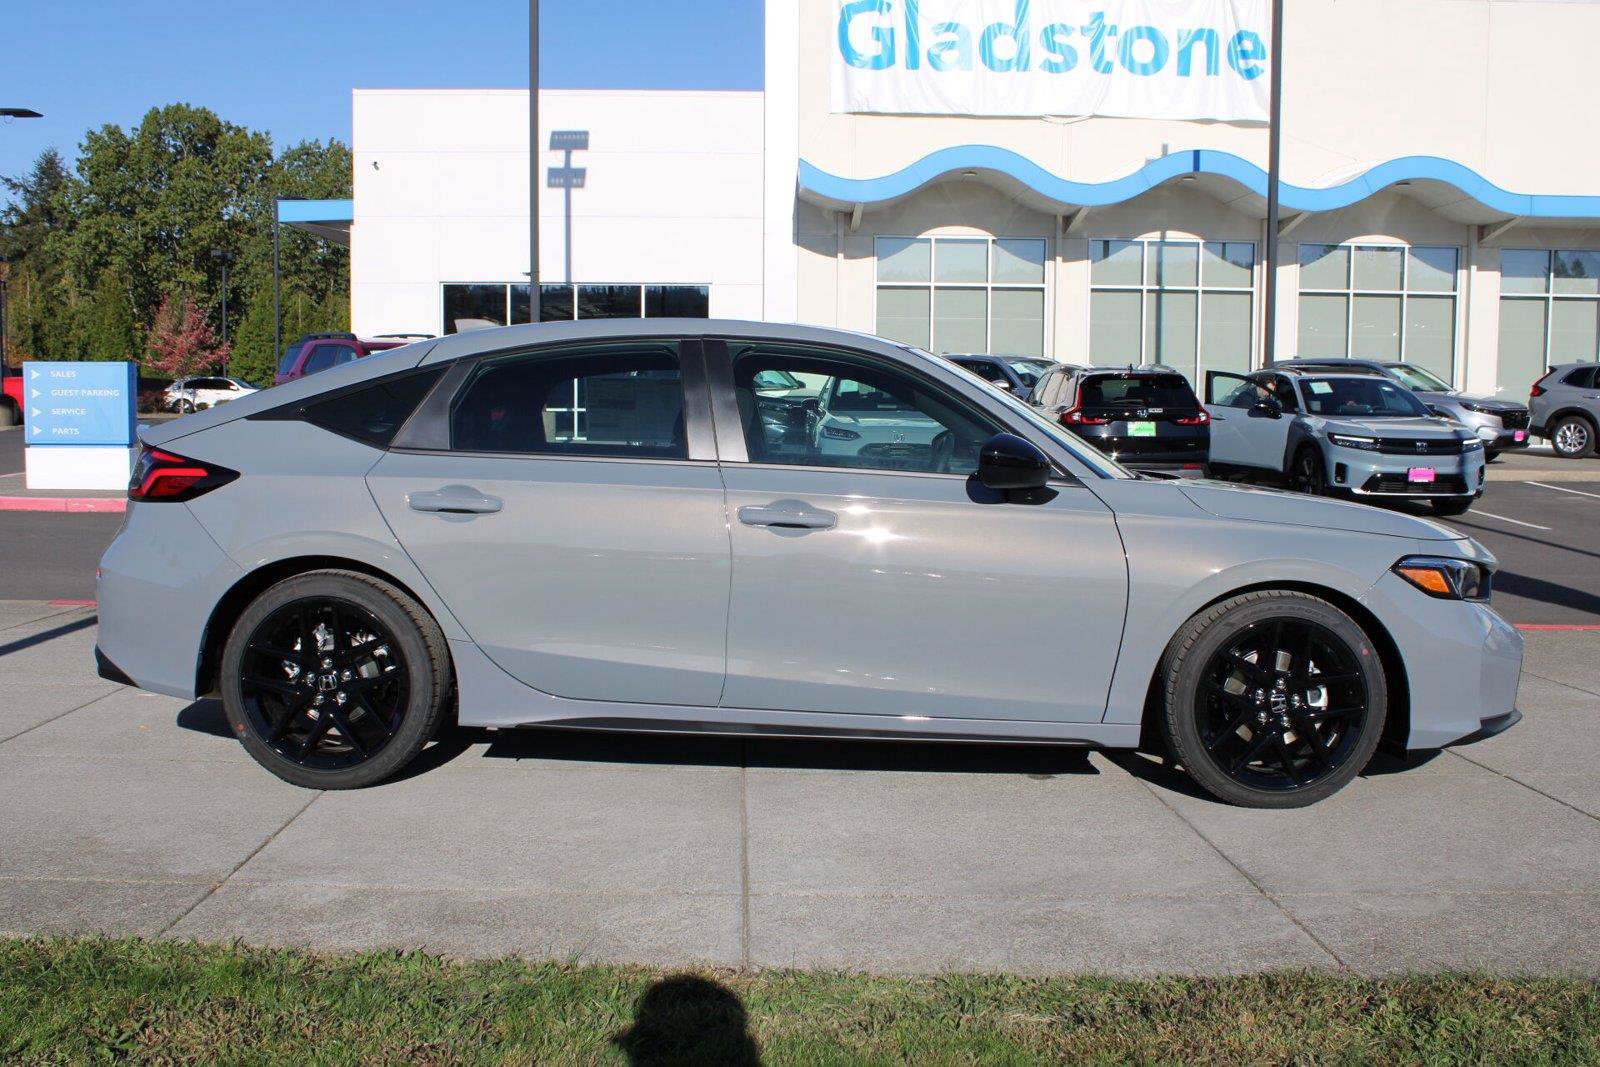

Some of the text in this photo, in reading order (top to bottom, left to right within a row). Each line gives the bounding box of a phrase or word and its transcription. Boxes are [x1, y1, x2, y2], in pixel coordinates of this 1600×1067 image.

[837, 0, 1267, 81] Gladstone
[50, 369, 77, 378] SALES
[50, 389, 120, 397] GUEST PARKING
[51, 408, 87, 416] SERVICE
[52, 427, 80, 435] PARTS
